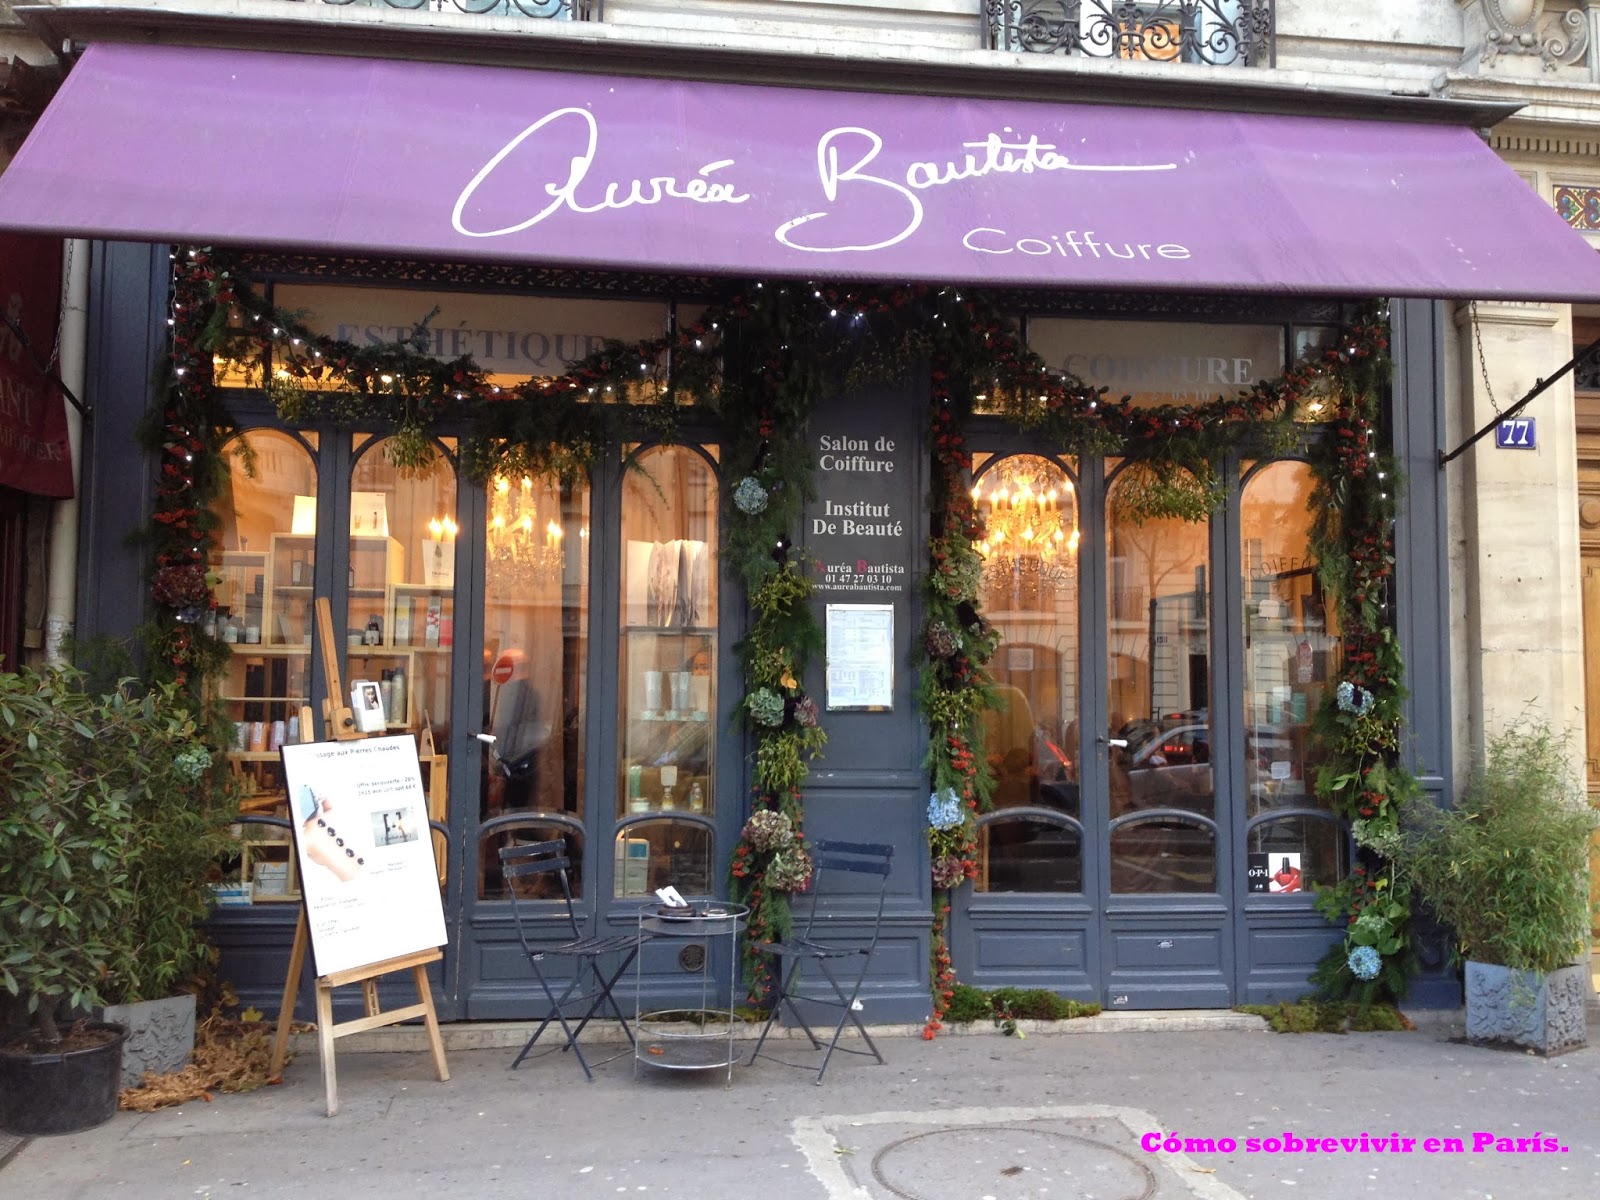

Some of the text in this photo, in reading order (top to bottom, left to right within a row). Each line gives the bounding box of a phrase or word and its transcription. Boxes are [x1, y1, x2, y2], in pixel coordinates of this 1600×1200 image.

[451, 107, 1177, 252] Auréa Bautista
[962, 227, 1191, 260] Coiffure
[1502, 420, 1529, 445] 77
[820, 435, 895, 452] Salon de
[819, 454, 894, 473] Coiffure
[825, 500, 890, 517] Institut
[812, 519, 903, 536] De Beauté
[813, 559, 905, 574] Auréa Bautista
[812, 583, 902, 592] www.aureabautista.com
[825, 574, 892, 584] 01 47 27 03 10
